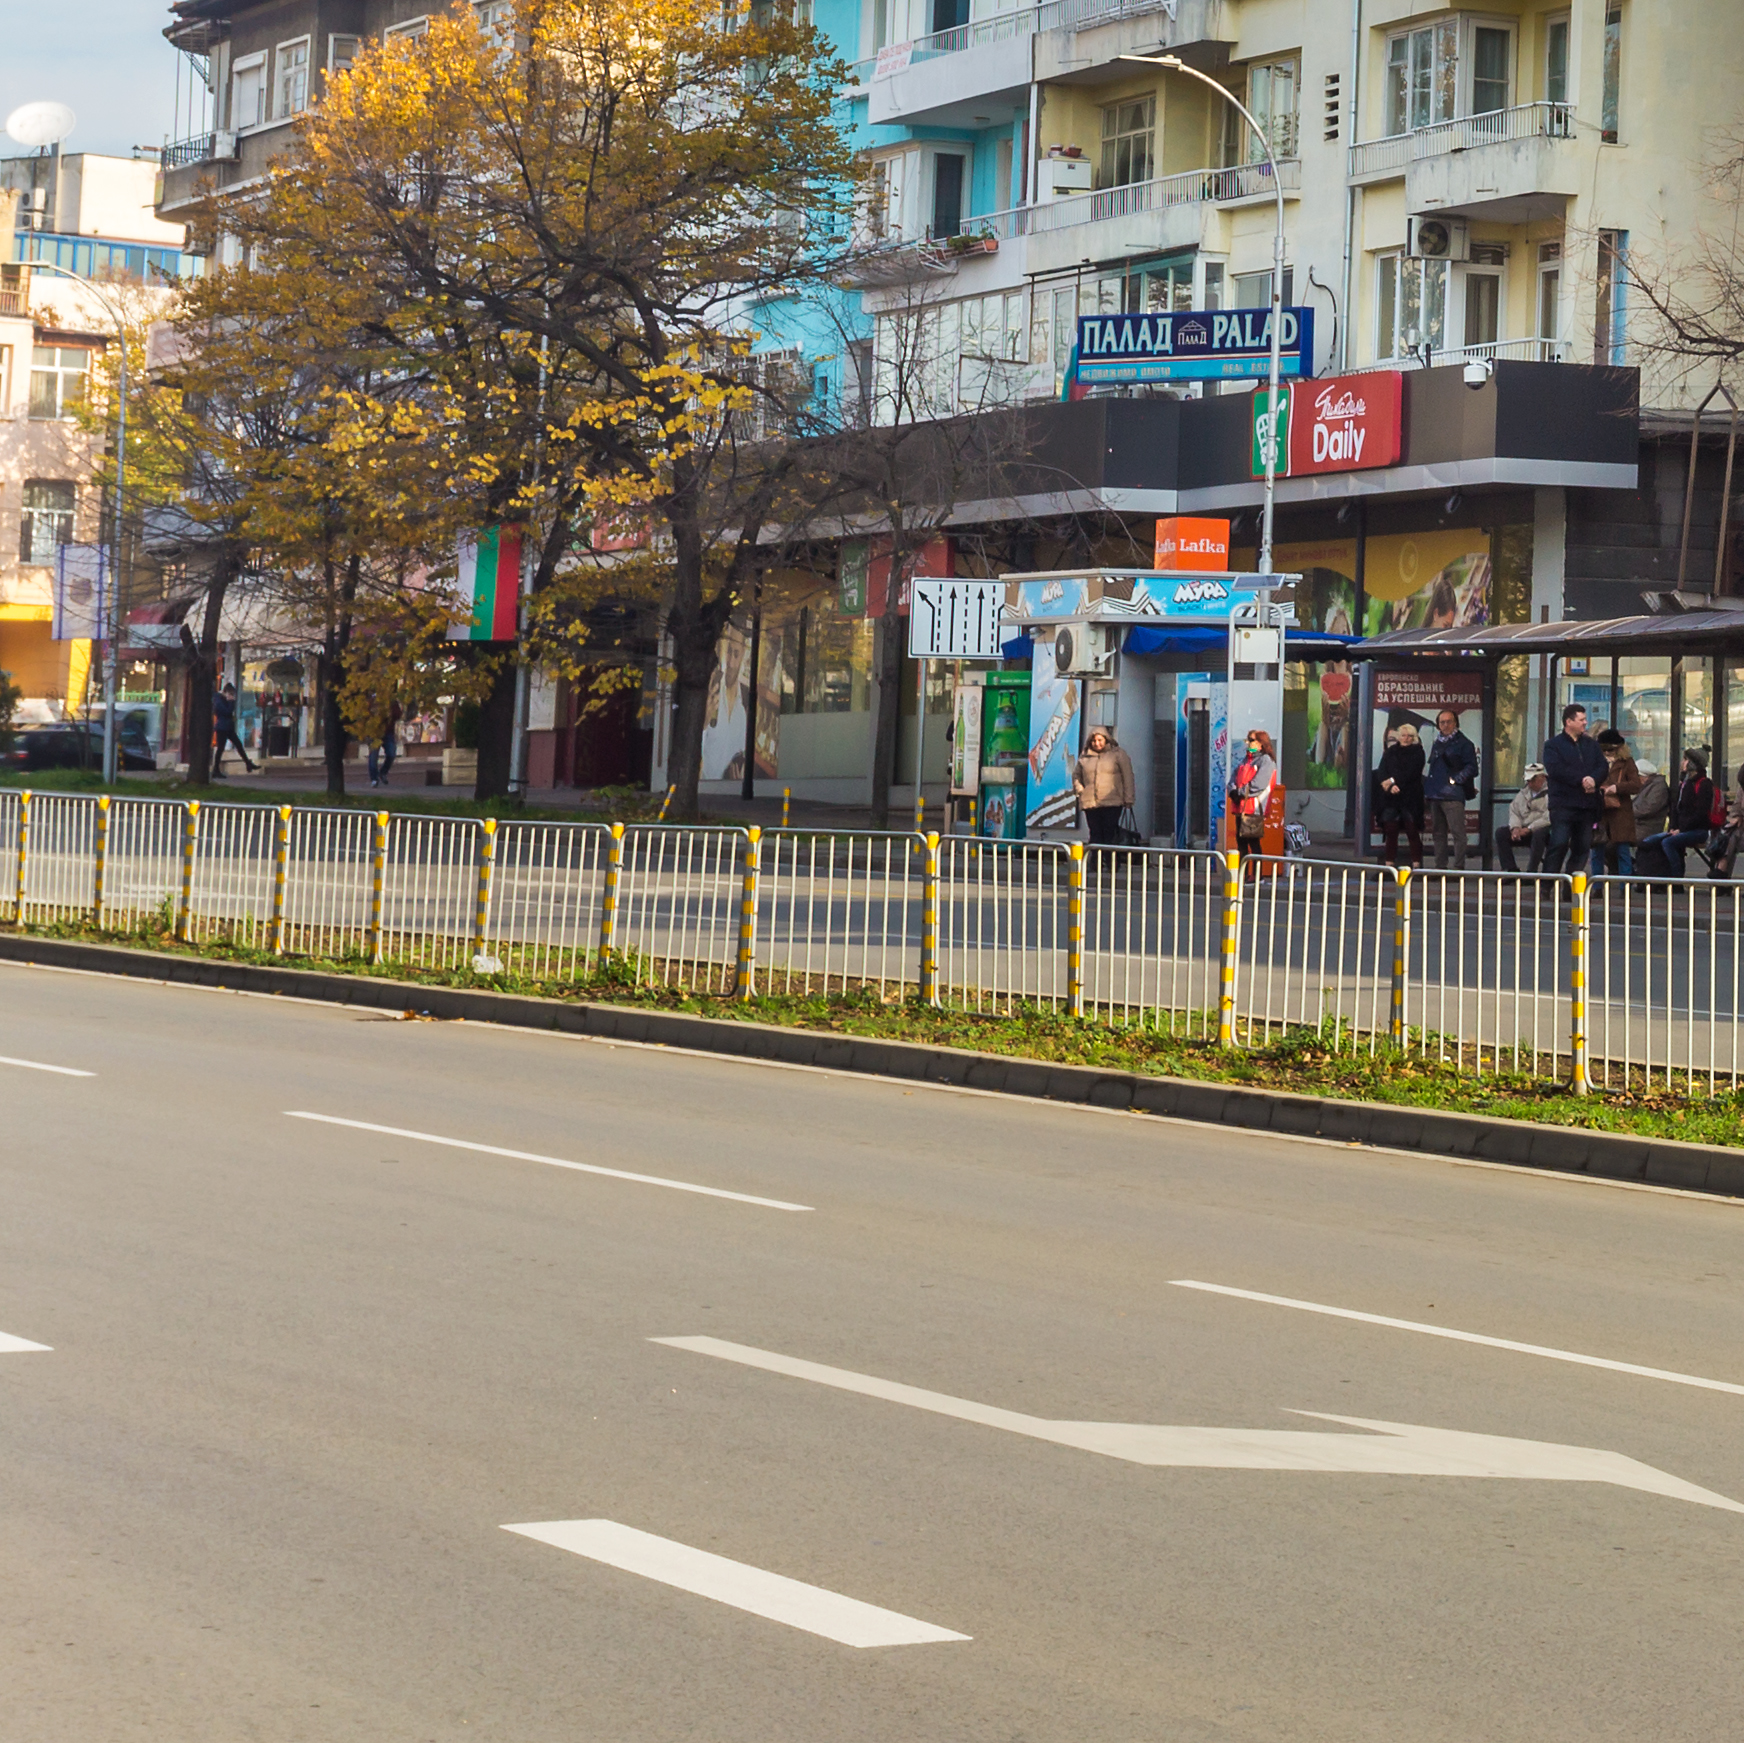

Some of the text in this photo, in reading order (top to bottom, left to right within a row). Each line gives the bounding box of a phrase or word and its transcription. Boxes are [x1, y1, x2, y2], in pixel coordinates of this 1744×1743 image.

[1082, 317, 1173, 355] ПАЛАД
[1212, 312, 1298, 349] PALAD
[1250, 361, 1286, 374] ESTE
[1313, 420, 1366, 463] Daily
[1179, 538, 1226, 554] Lafka
[1377, 682, 1445, 693] ОБРАЗОВАНИЕ
[1377, 693, 1481, 705] ЗА УСПЕШНА КАРИЕРА
